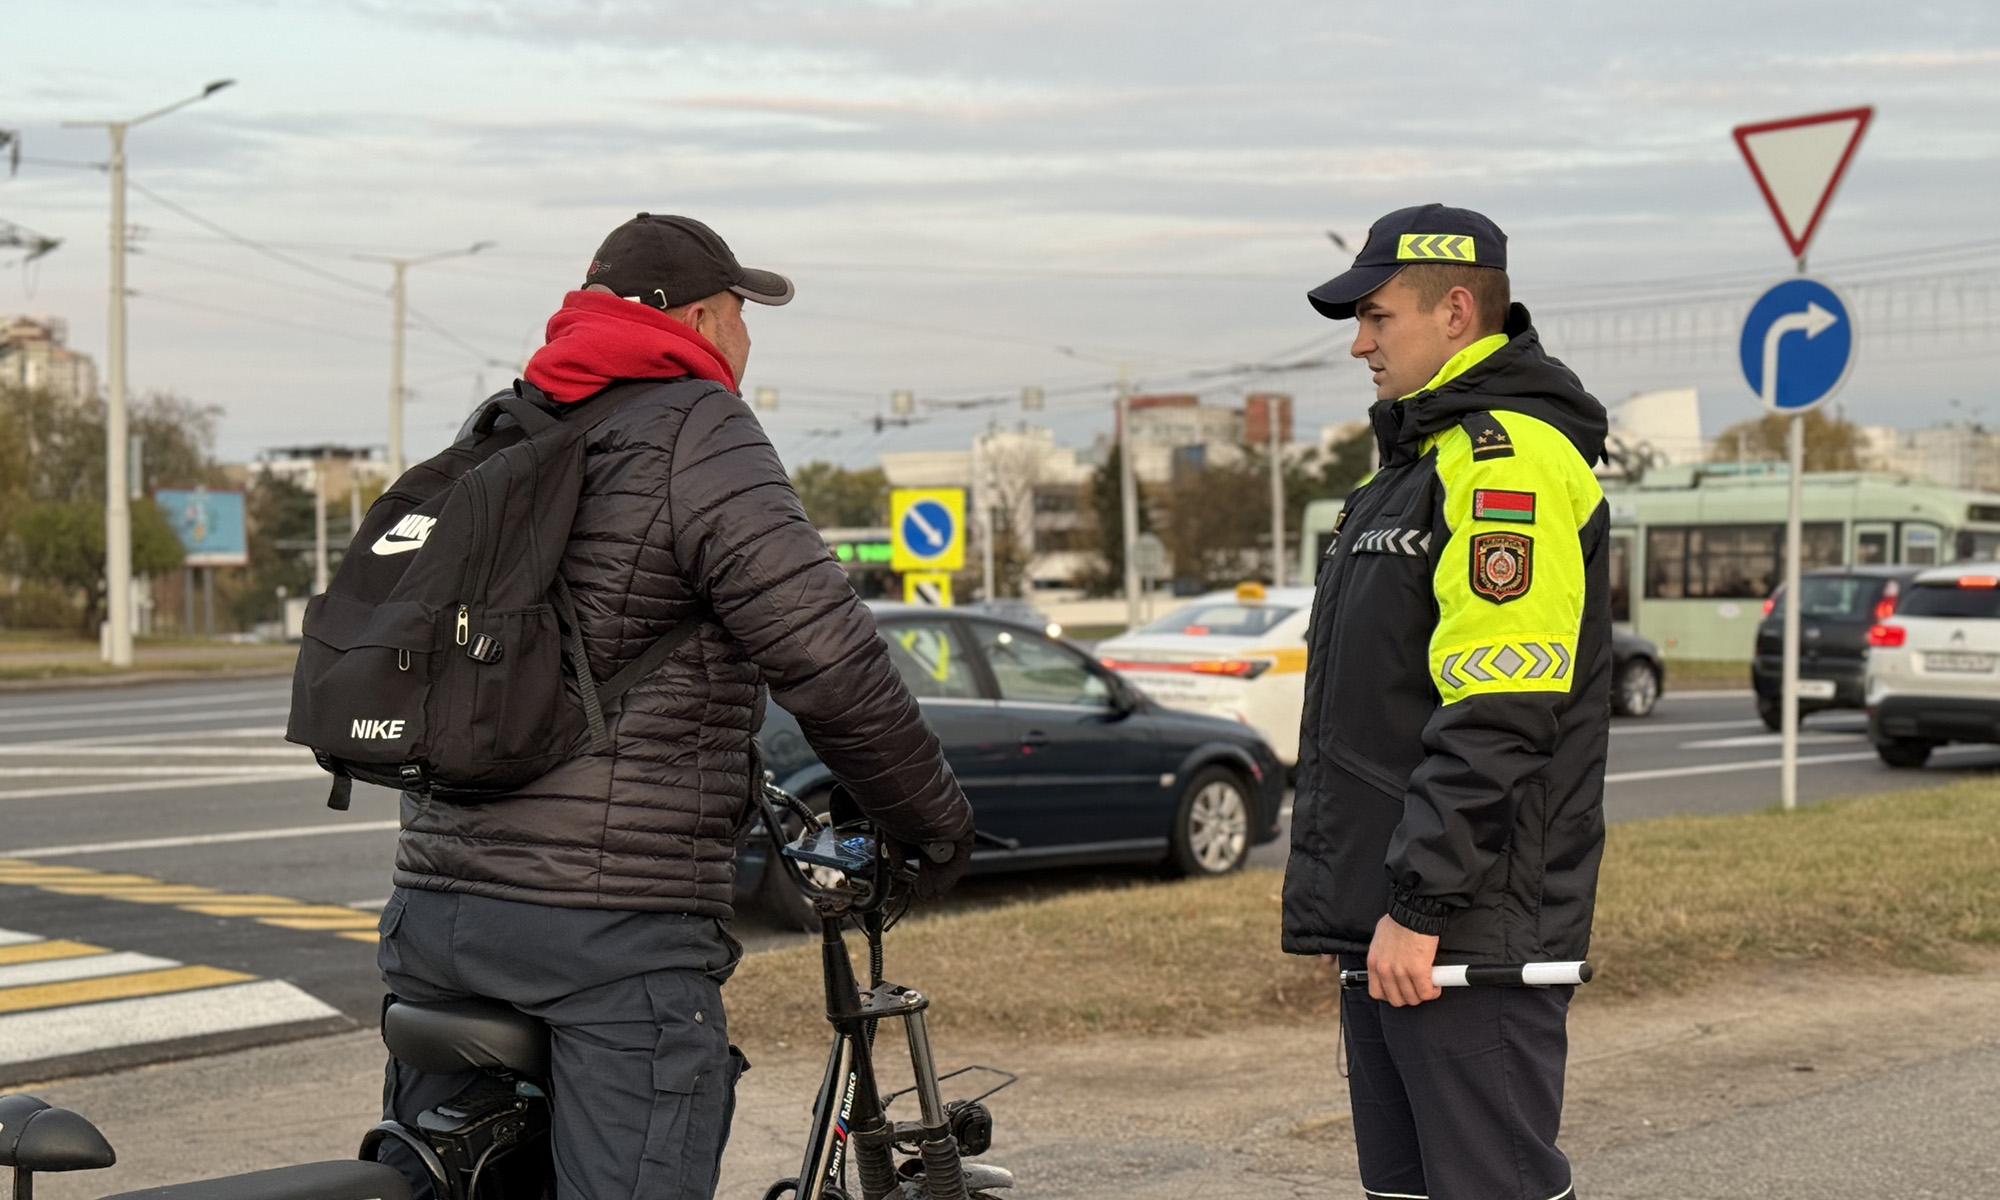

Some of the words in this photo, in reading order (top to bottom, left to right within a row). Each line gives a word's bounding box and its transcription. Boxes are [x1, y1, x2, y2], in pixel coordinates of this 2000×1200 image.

[388, 514, 438, 541] NIK
[351, 719, 406, 739] NIKE
[829, 1140, 844, 1178] Smart
[841, 1072, 857, 1120] Balance
